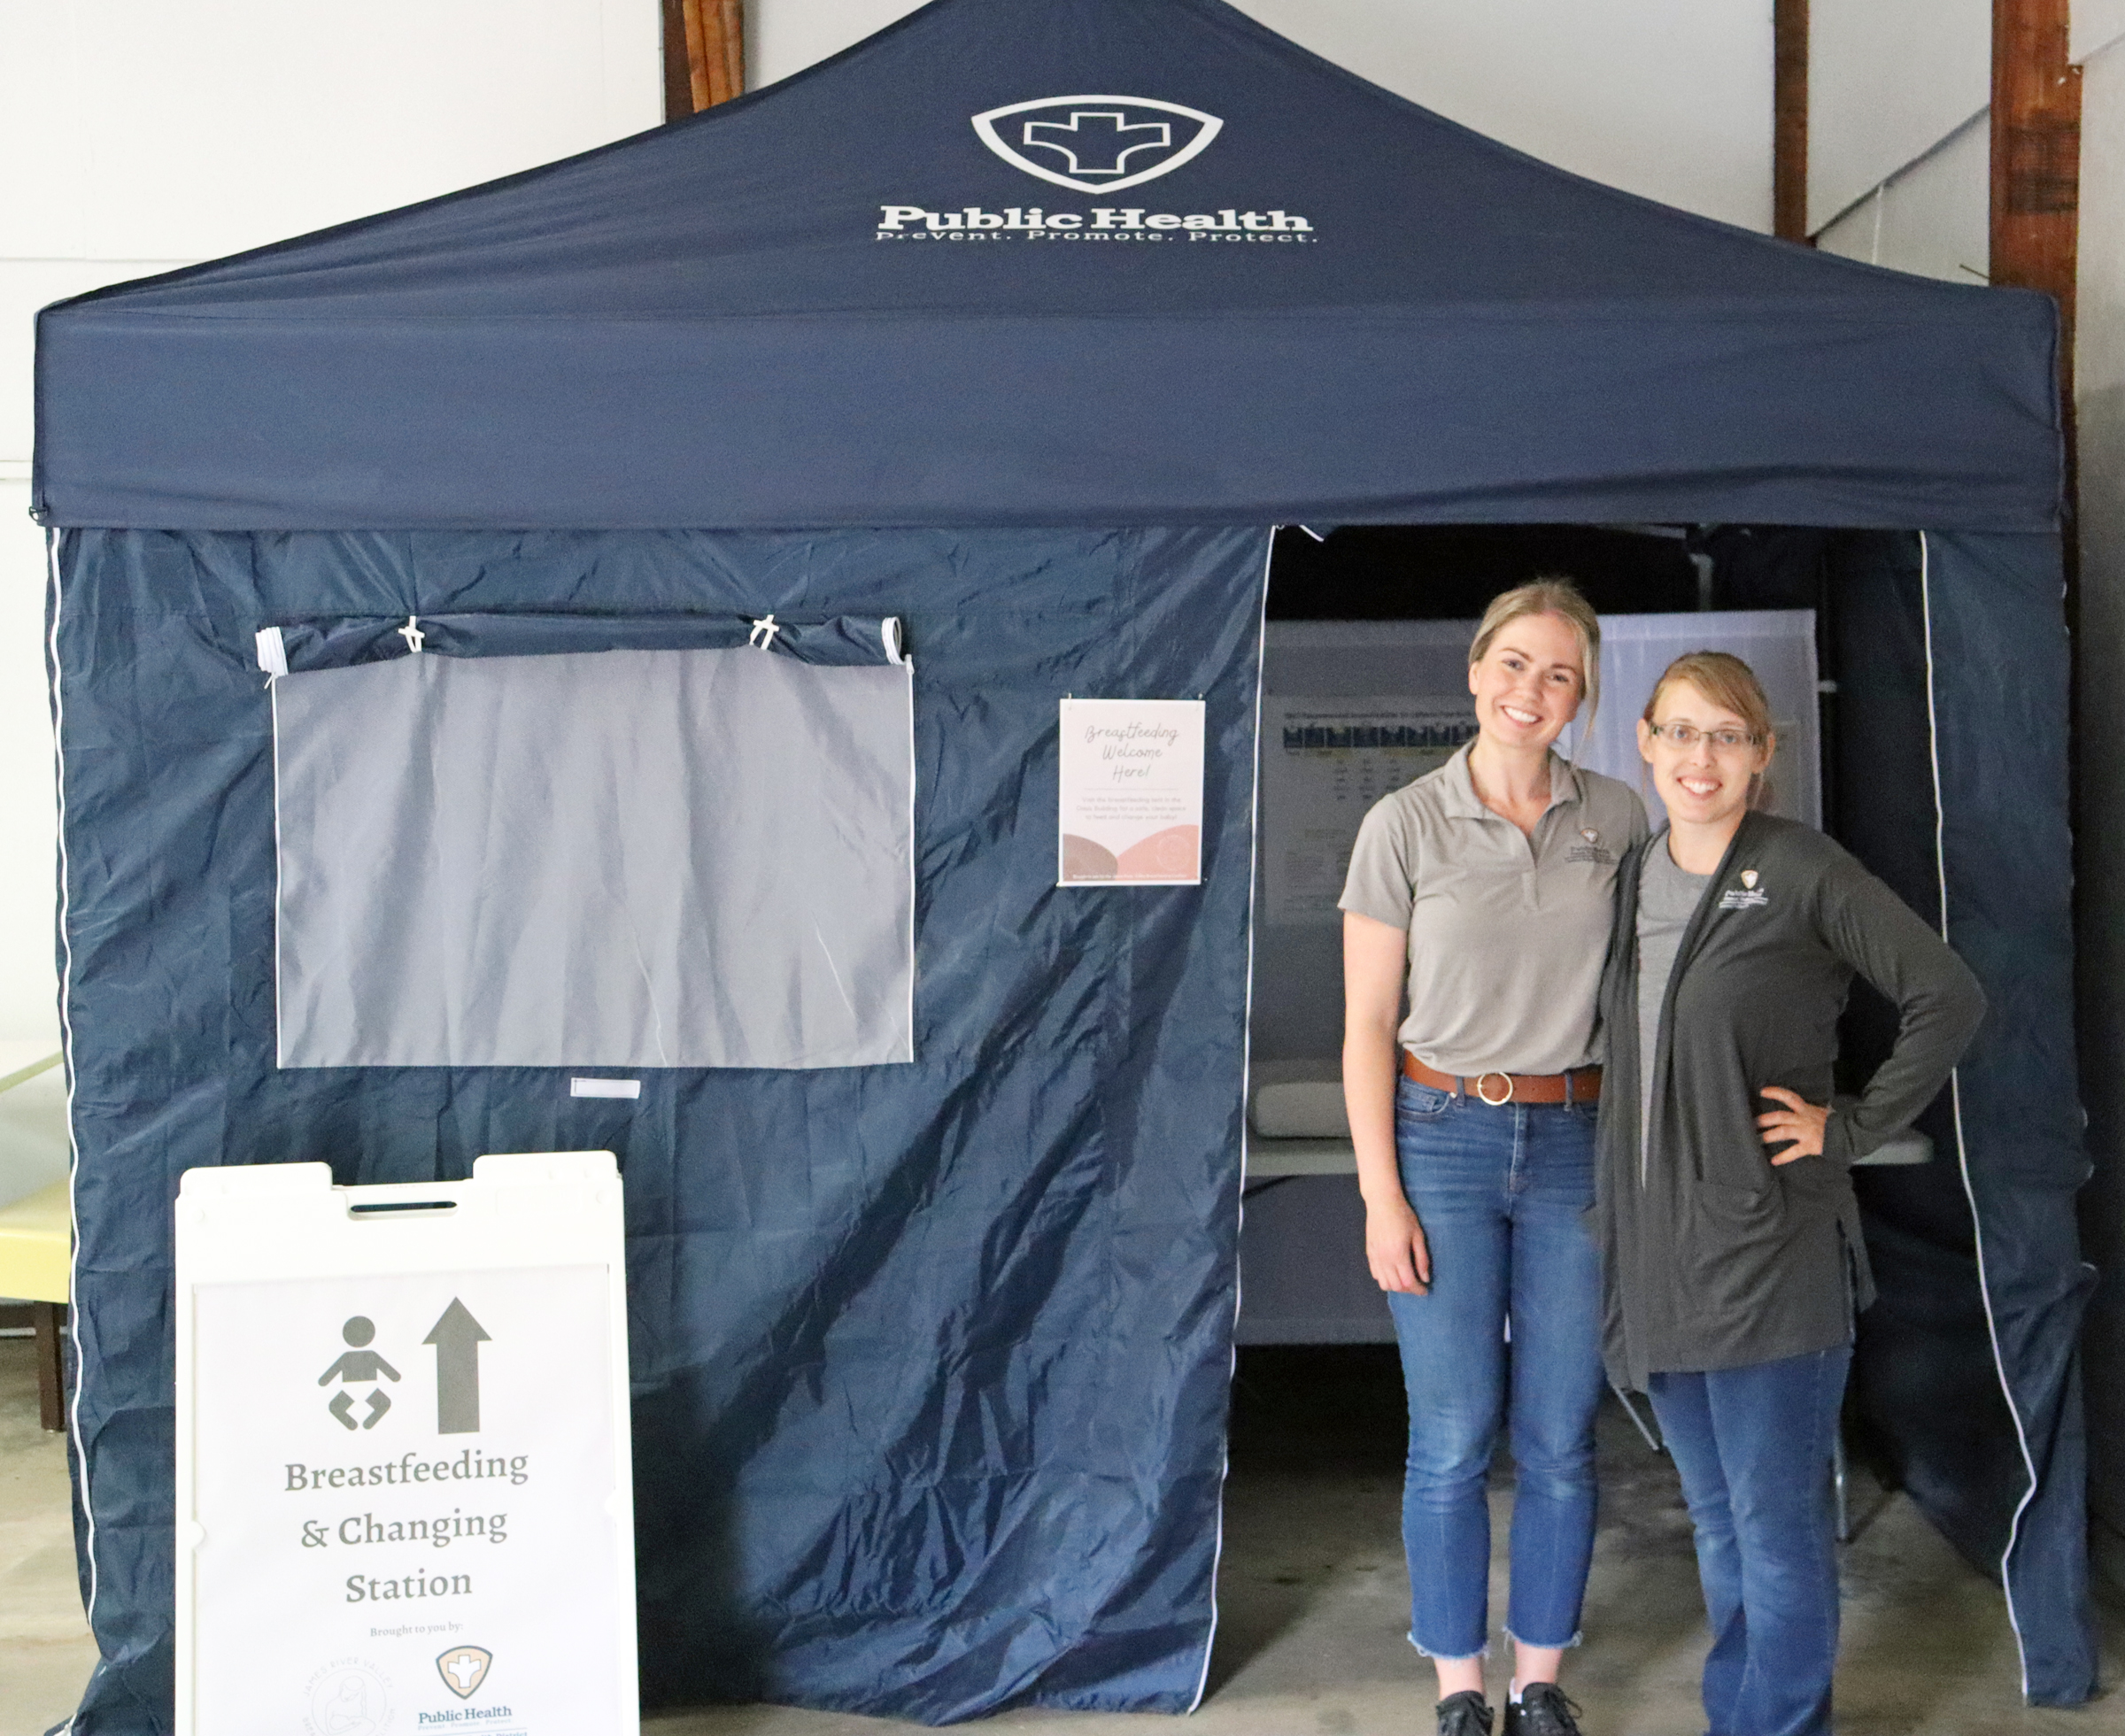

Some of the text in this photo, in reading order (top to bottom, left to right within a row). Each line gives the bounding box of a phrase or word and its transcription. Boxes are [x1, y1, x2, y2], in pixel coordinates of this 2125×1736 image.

[880, 205, 1314, 232] Public Health
[876, 230, 1318, 243] Prevent. Promote. Protect.
[1085, 721, 1180, 746] Breastfeeding
[1102, 743, 1163, 760] Welcome
[1111, 764, 1151, 783] Here!
[284, 1449, 529, 1491] Breastfeeding
[301, 1508, 507, 1548] & Changing
[346, 1568, 472, 1603] Station
[370, 1624, 413, 1638] Brought
[427, 1624, 446, 1635] you
[448, 1621, 464, 1633] by:
[303, 1656, 394, 1697] JAMES RIVER VALLEY
[418, 1705, 513, 1724] Public Health
